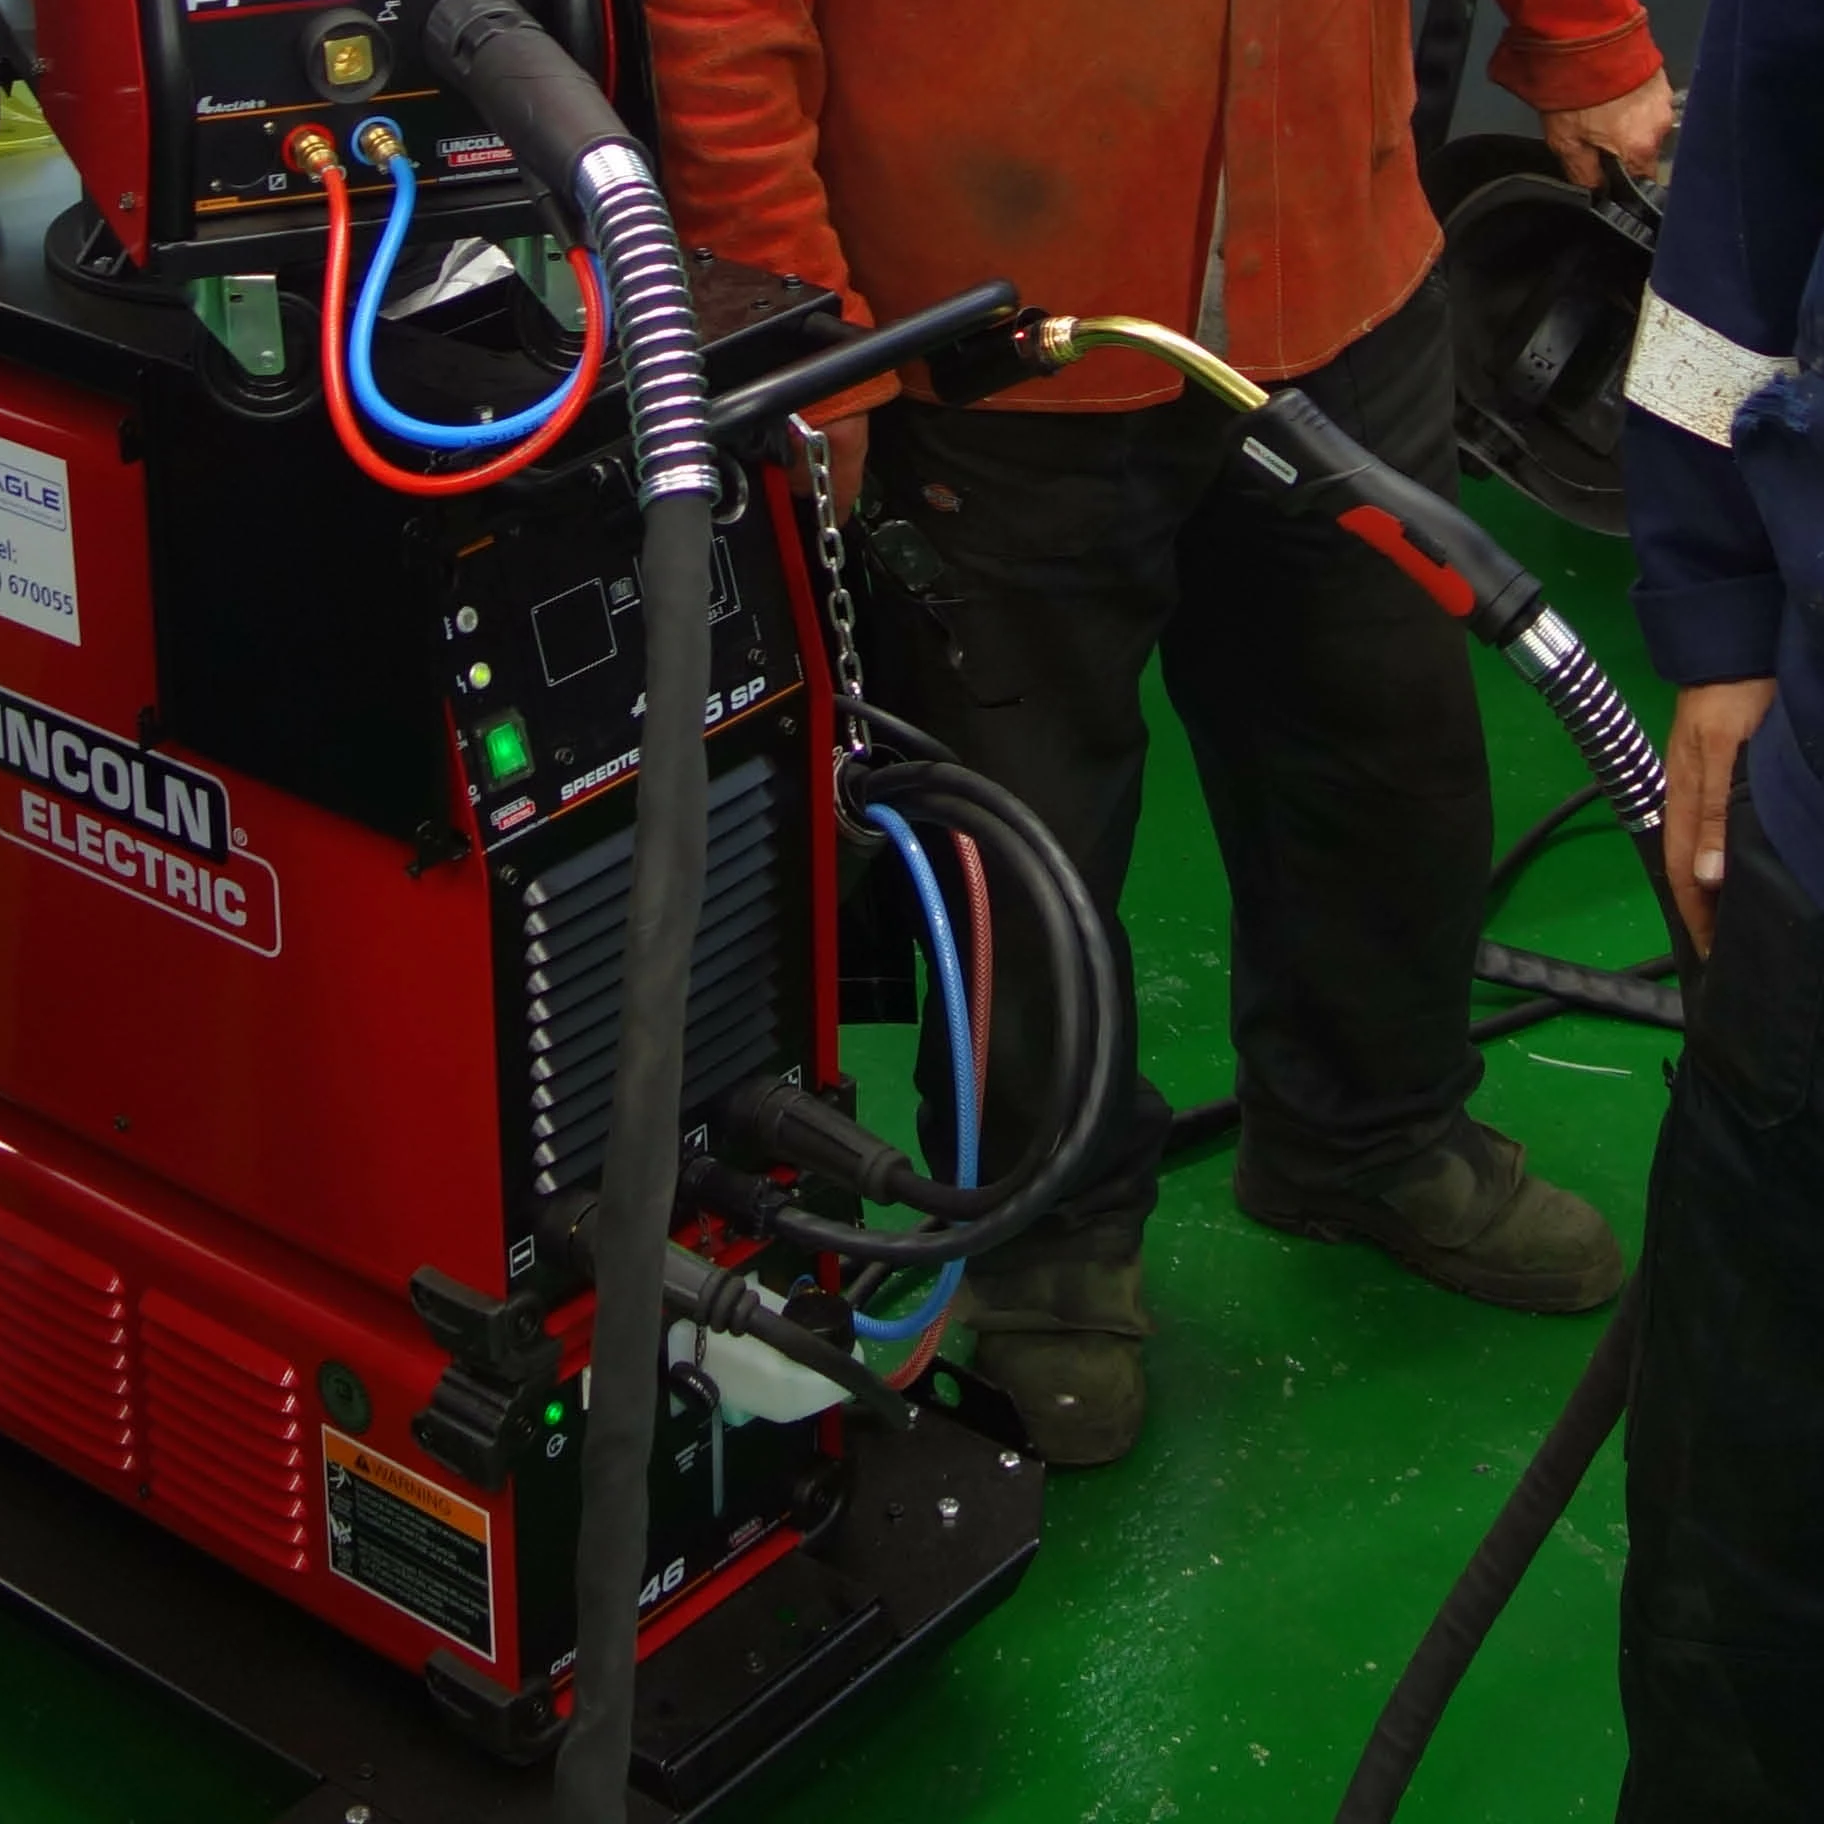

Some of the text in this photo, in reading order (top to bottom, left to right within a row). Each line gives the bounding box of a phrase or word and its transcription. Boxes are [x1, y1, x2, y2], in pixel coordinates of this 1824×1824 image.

[7, 574, 74, 616] 670055
[560, 747, 641, 801] SPEEDTE
[730, 675, 767, 711] SP
[20, 789, 247, 927] ELECTRIC
[373, 1461, 453, 1518] WARNING
[638, 1556, 687, 1608] 46
